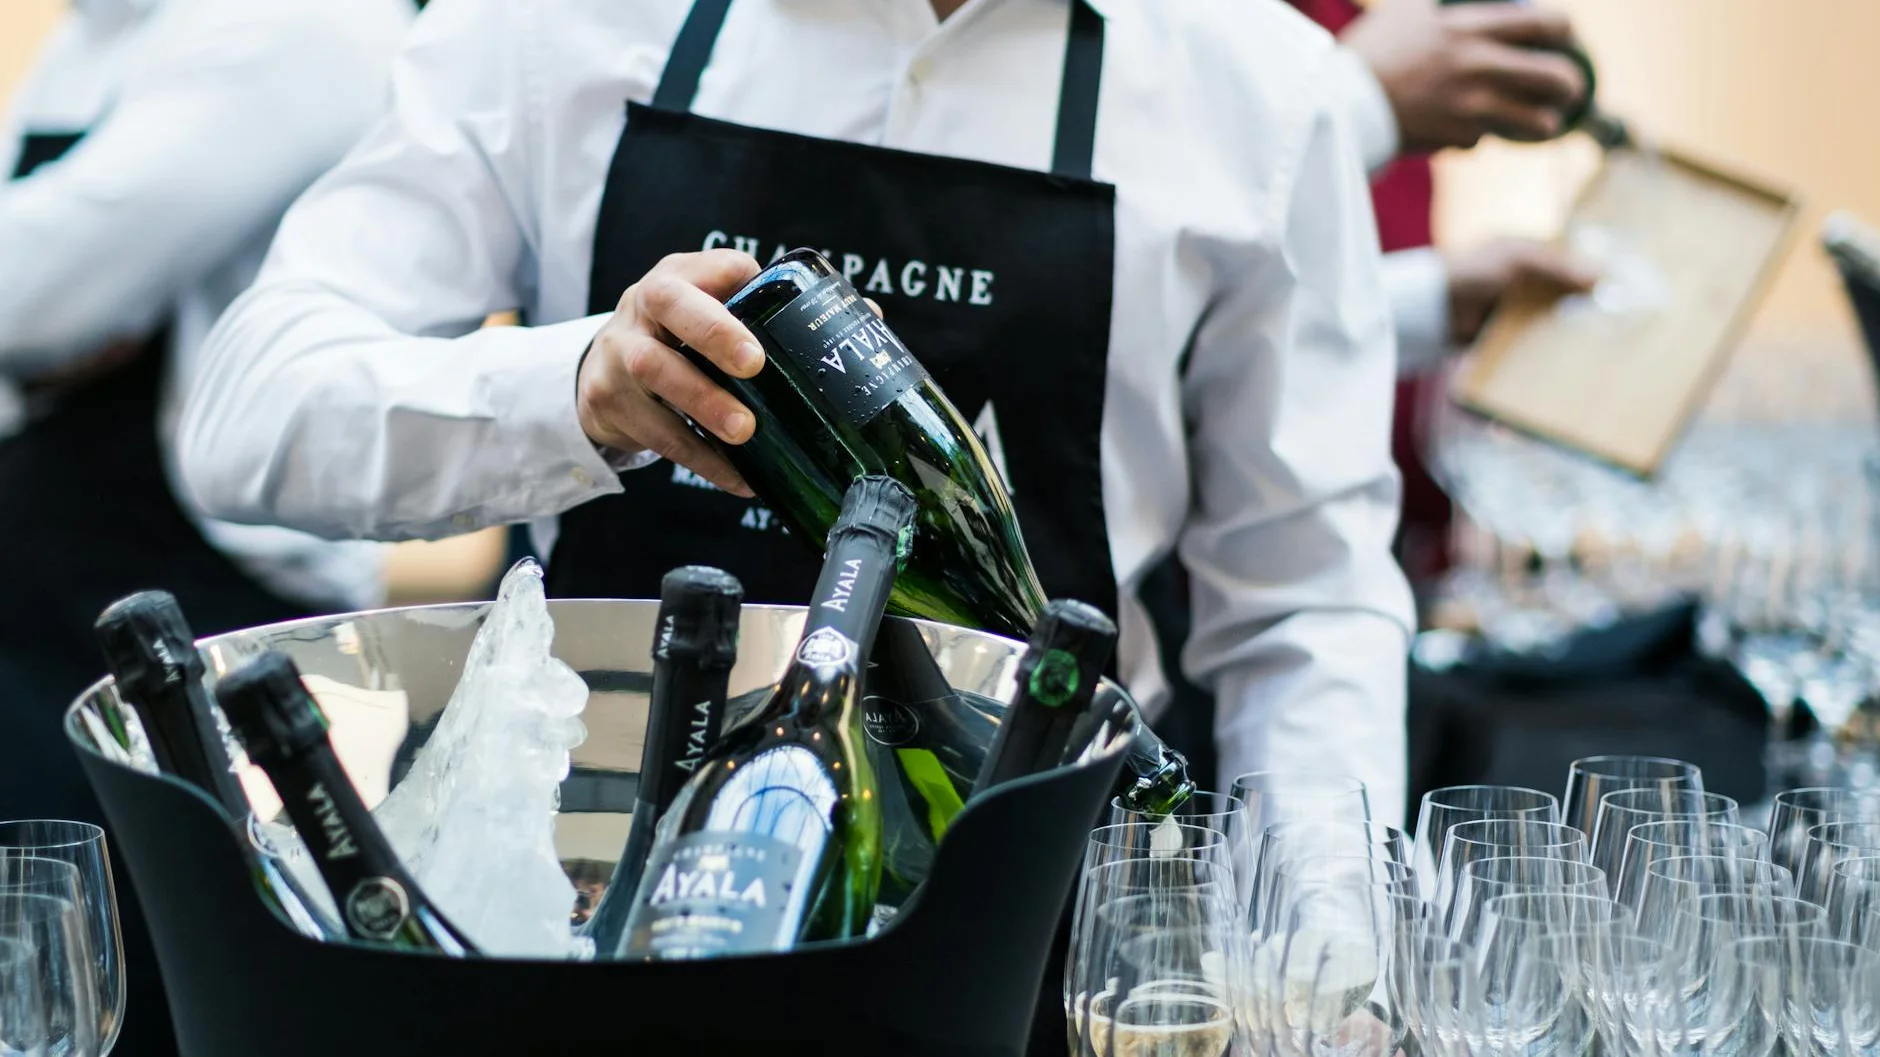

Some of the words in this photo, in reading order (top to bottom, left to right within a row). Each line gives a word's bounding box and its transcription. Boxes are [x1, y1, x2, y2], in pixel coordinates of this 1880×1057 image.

[701, 230, 995, 305] CHPAGNE
[808, 304, 842, 331] MAJEUR
[820, 318, 905, 374] AYALA
[861, 355, 913, 396] CHAMPAGNE
[821, 559, 862, 612] AYALA
[657, 615, 675, 659] AYALA
[674, 700, 713, 771] AYALA
[650, 863, 767, 908] AYALA
